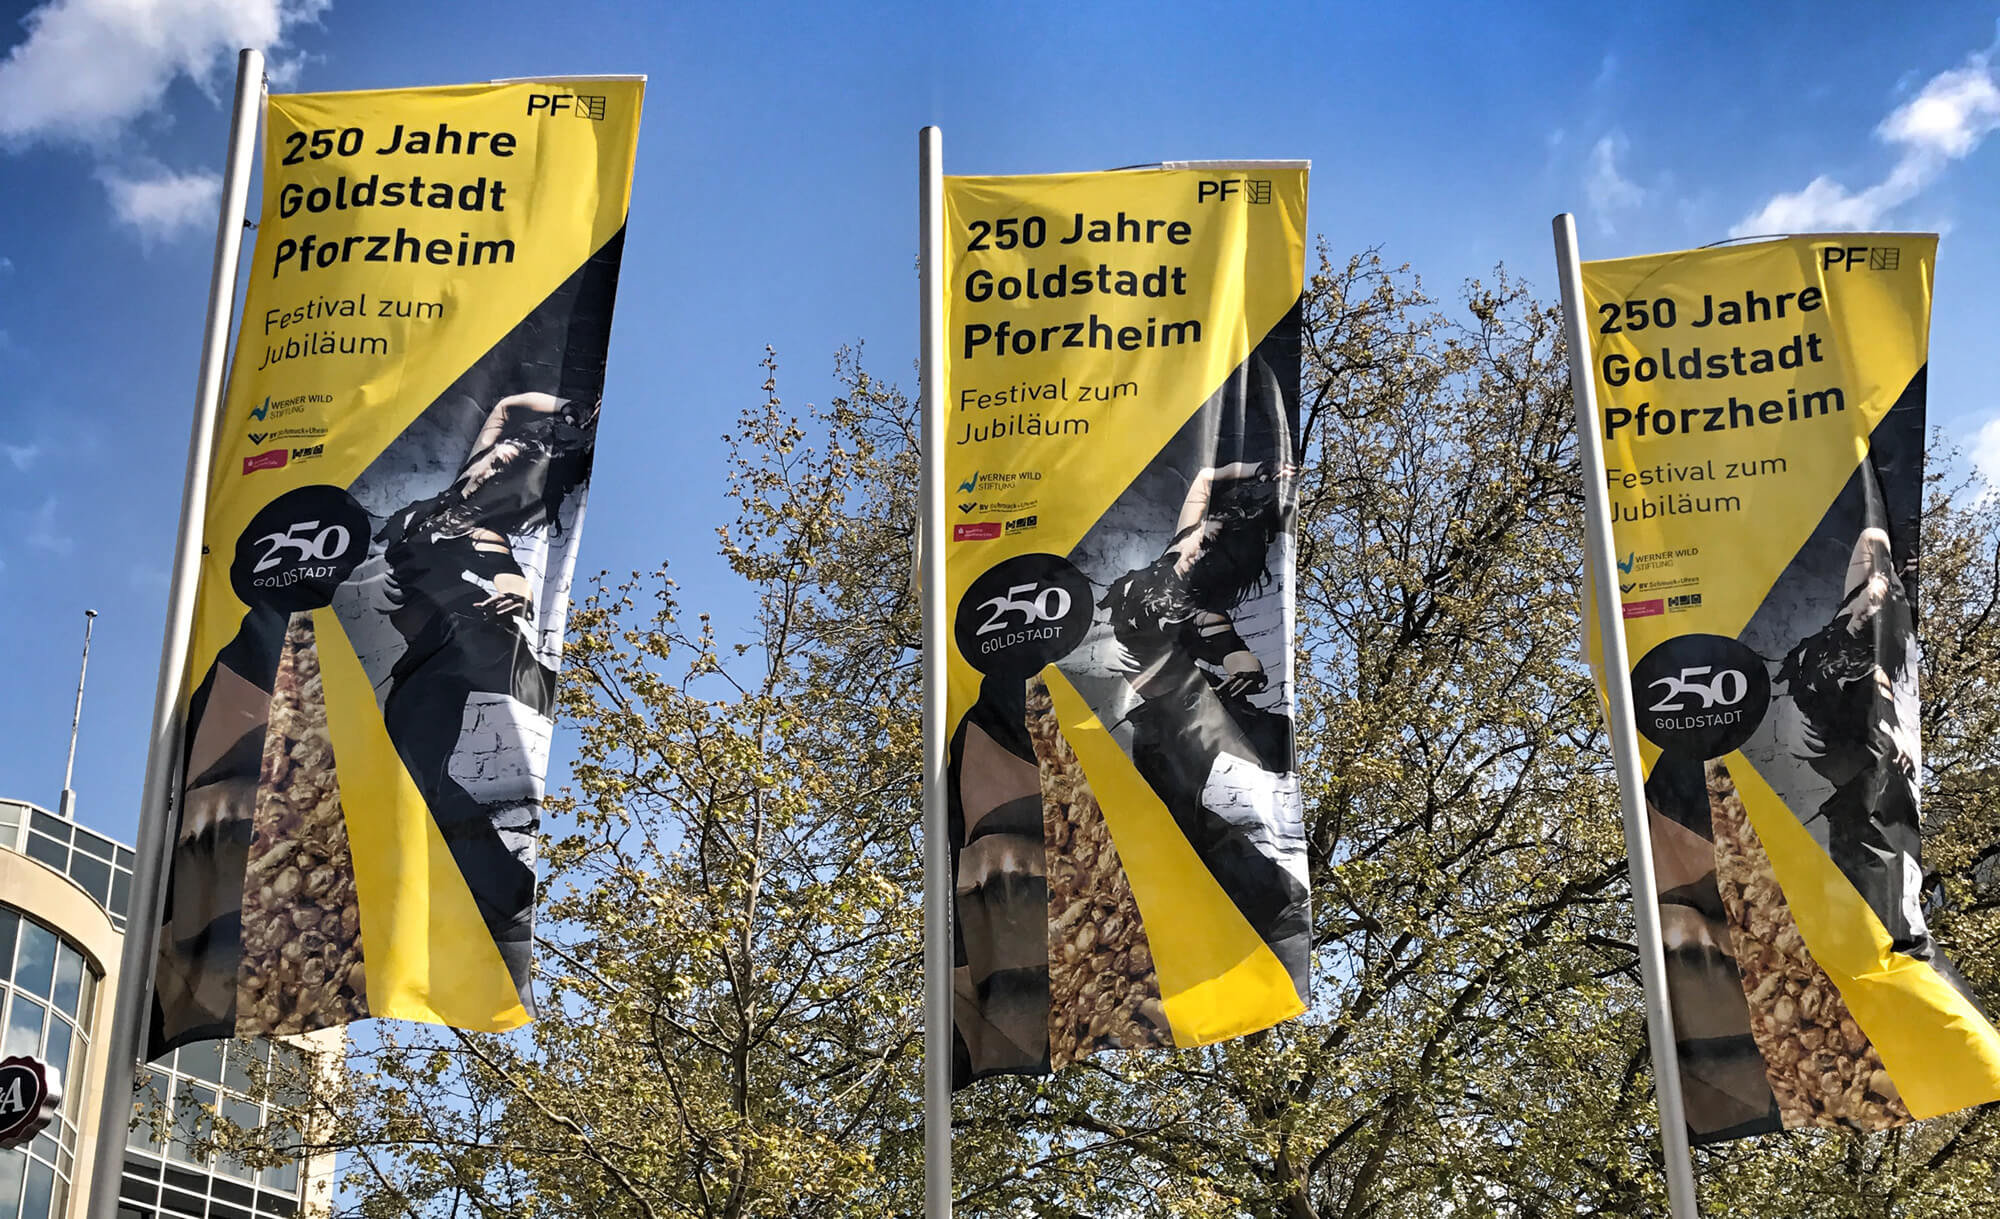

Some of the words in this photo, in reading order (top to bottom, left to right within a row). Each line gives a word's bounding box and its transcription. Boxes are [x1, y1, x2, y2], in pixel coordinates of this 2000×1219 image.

[527, 94, 573, 117] PF
[281, 127, 363, 166] 250
[376, 123, 517, 158] Jahre
[279, 175, 506, 220] Goldstadt
[1198, 179, 1241, 204] PF
[967, 216, 1046, 252] 250
[1060, 212, 1192, 245] Jahre
[272, 228, 515, 279] Pforzheim
[1823, 246, 1868, 273] PF
[964, 264, 1187, 303] Goldstadt
[264, 294, 367, 335] Festival
[377, 299, 444, 319] zum
[1598, 297, 1676, 335] 250
[1690, 286, 1823, 328] Jahre
[258, 330, 388, 371] Jubiläum
[963, 314, 1201, 359] Pforzheim
[1602, 332, 1824, 387] Goldstadt
[271, 396, 306, 410] WERNER
[308, 394, 333, 403] WILD
[960, 377, 1069, 412] Festival
[1078, 382, 1138, 402] zum
[1604, 386, 1845, 441] Pforzheim
[956, 413, 1090, 445] Jubiläum
[979, 473, 1016, 482] WERNER
[1019, 472, 1042, 481] WILD
[1607, 460, 1716, 489] Festival
[1726, 456, 1787, 478] zum
[1611, 492, 1741, 523] Jubiläum
[252, 520, 350, 574] 250
[1635, 551, 1673, 563] WERNER
[1675, 547, 1699, 557] WILD
[253, 566, 337, 588] GOLDSTADT
[976, 582, 1072, 636] 250
[981, 626, 1063, 654] GOLDSTADT
[1648, 665, 1748, 712] 250
[1655, 710, 1743, 730] GOLDSTADT
